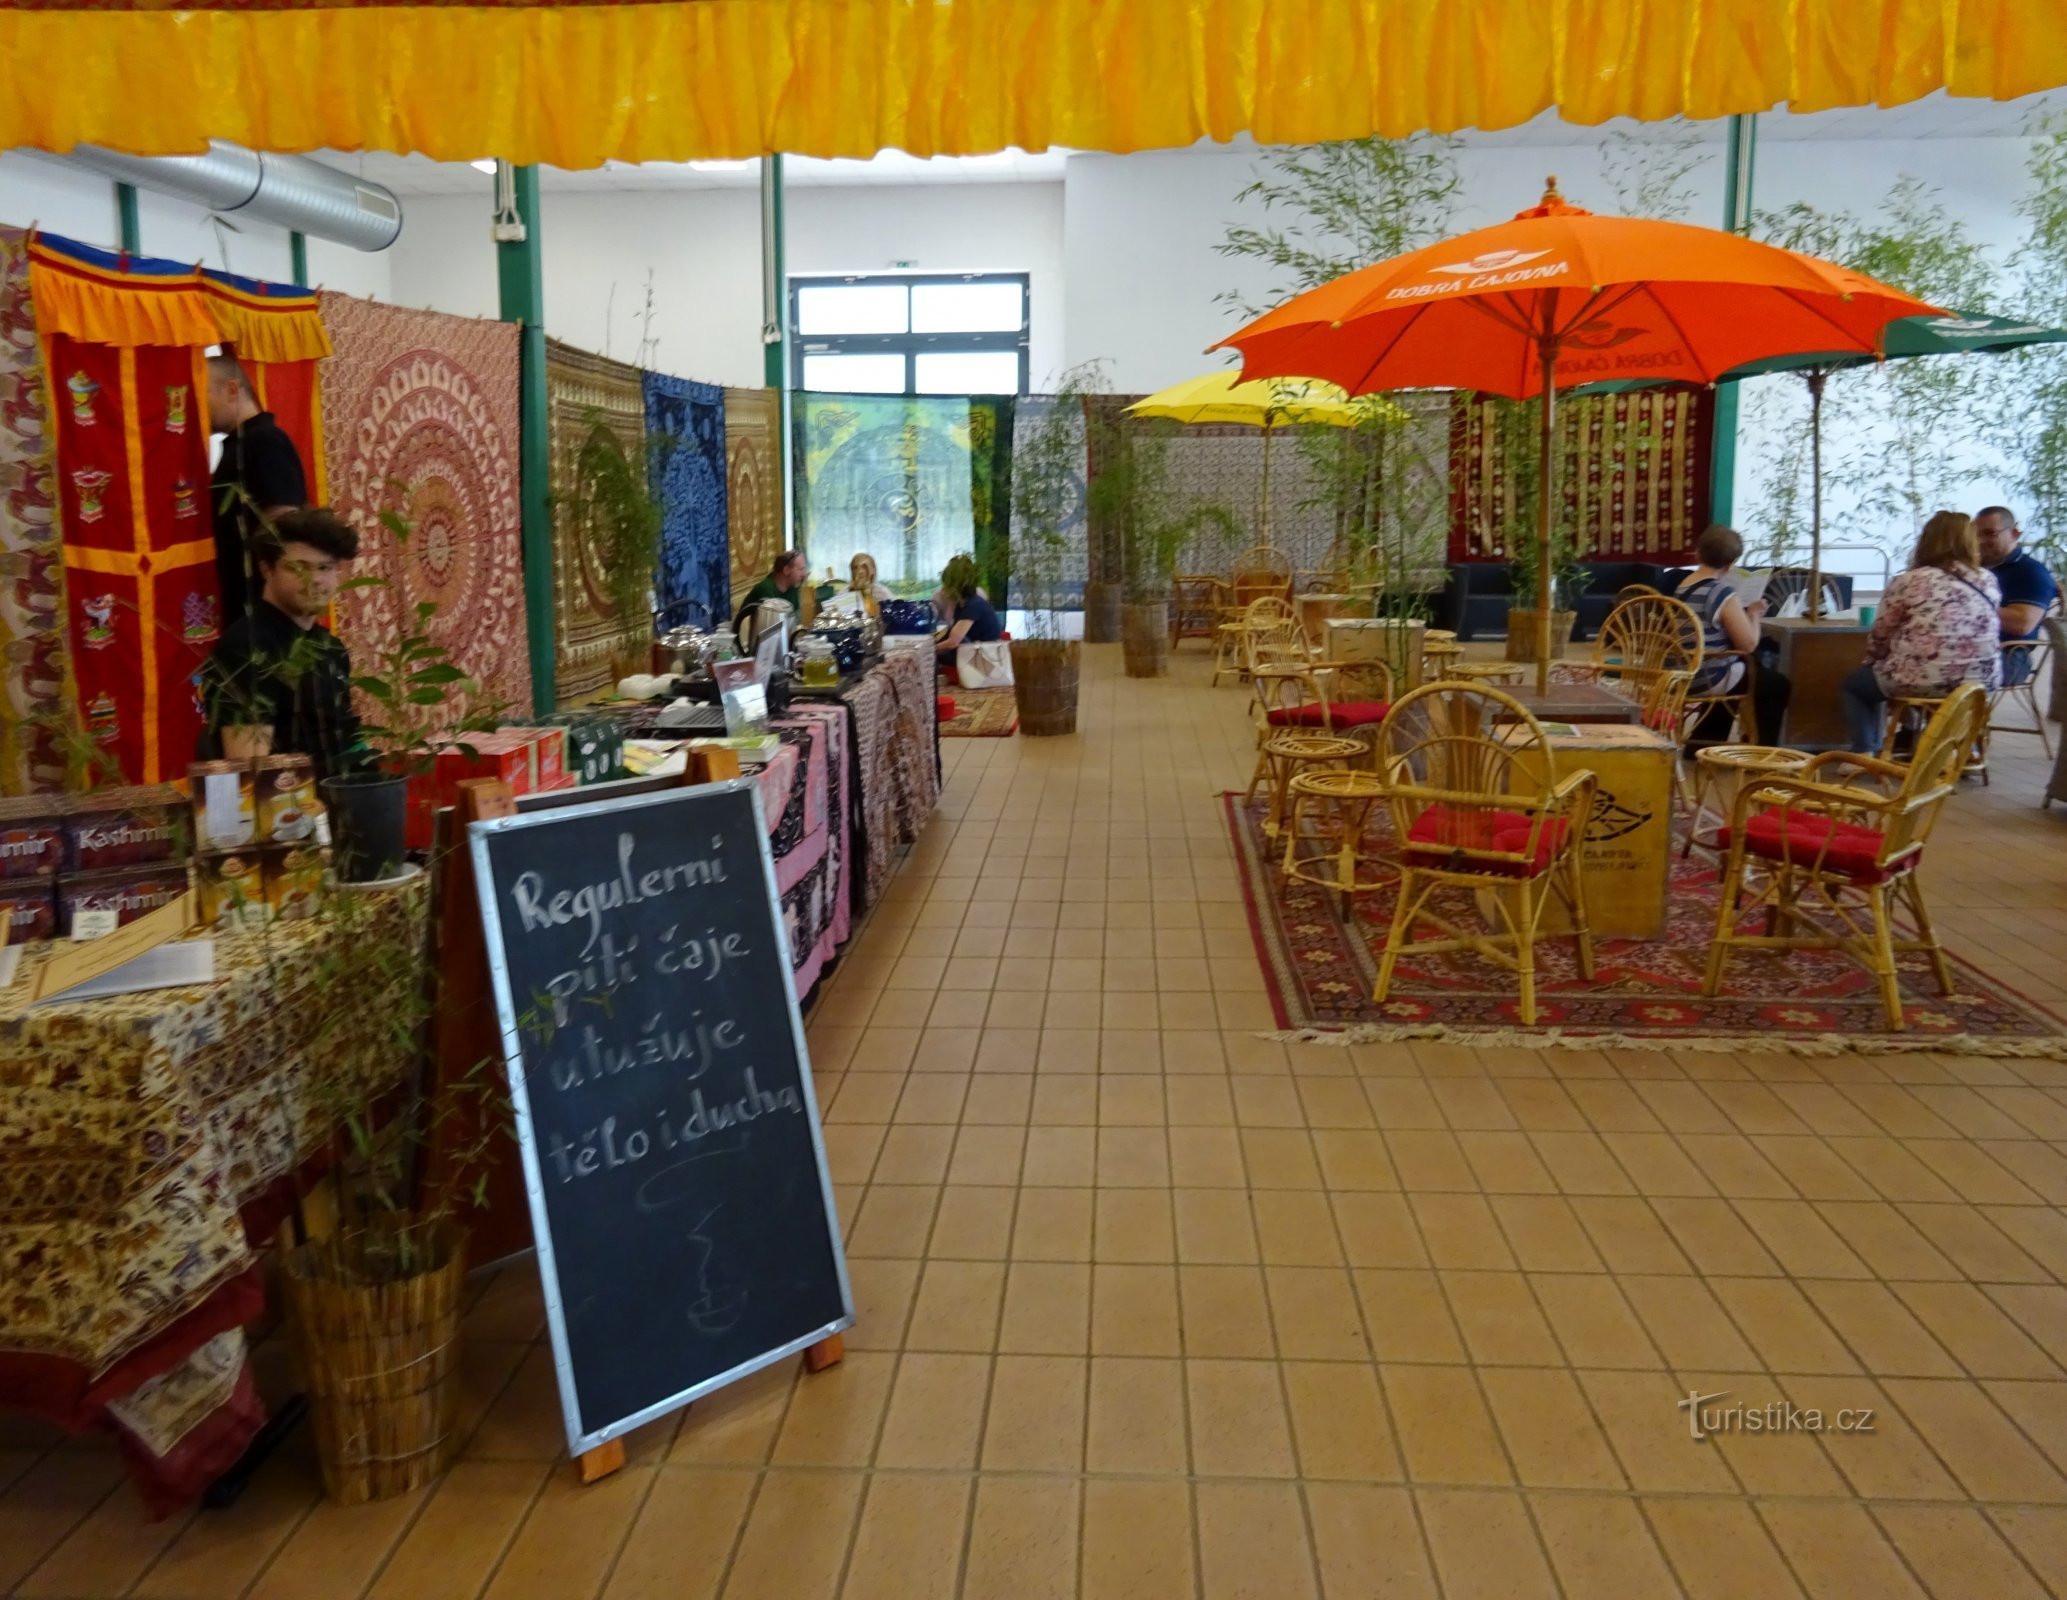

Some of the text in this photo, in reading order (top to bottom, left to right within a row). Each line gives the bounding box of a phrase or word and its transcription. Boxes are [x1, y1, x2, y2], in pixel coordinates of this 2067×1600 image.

[1385, 260, 1569, 300] DOBRÁ ČAJOVNA
[681, 1066, 803, 1142] ducha
